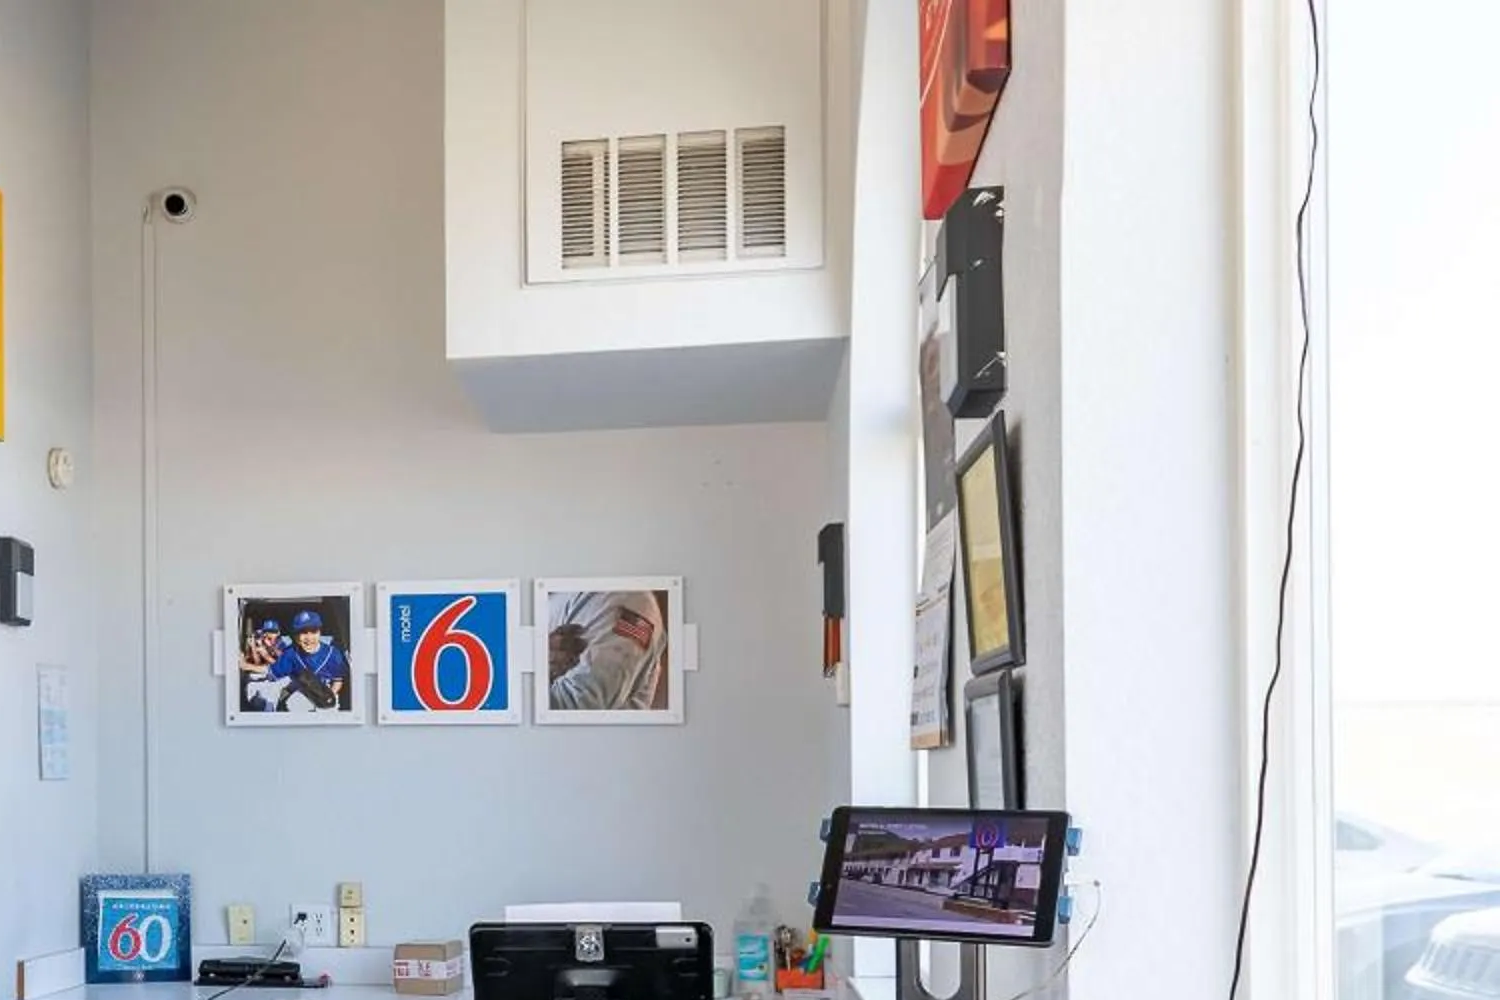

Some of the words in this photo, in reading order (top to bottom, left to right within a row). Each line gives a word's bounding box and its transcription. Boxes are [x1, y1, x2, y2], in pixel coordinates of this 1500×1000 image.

[401, 605, 412, 643] motel
[411, 595, 493, 711] 6
[107, 912, 173, 963] 60
